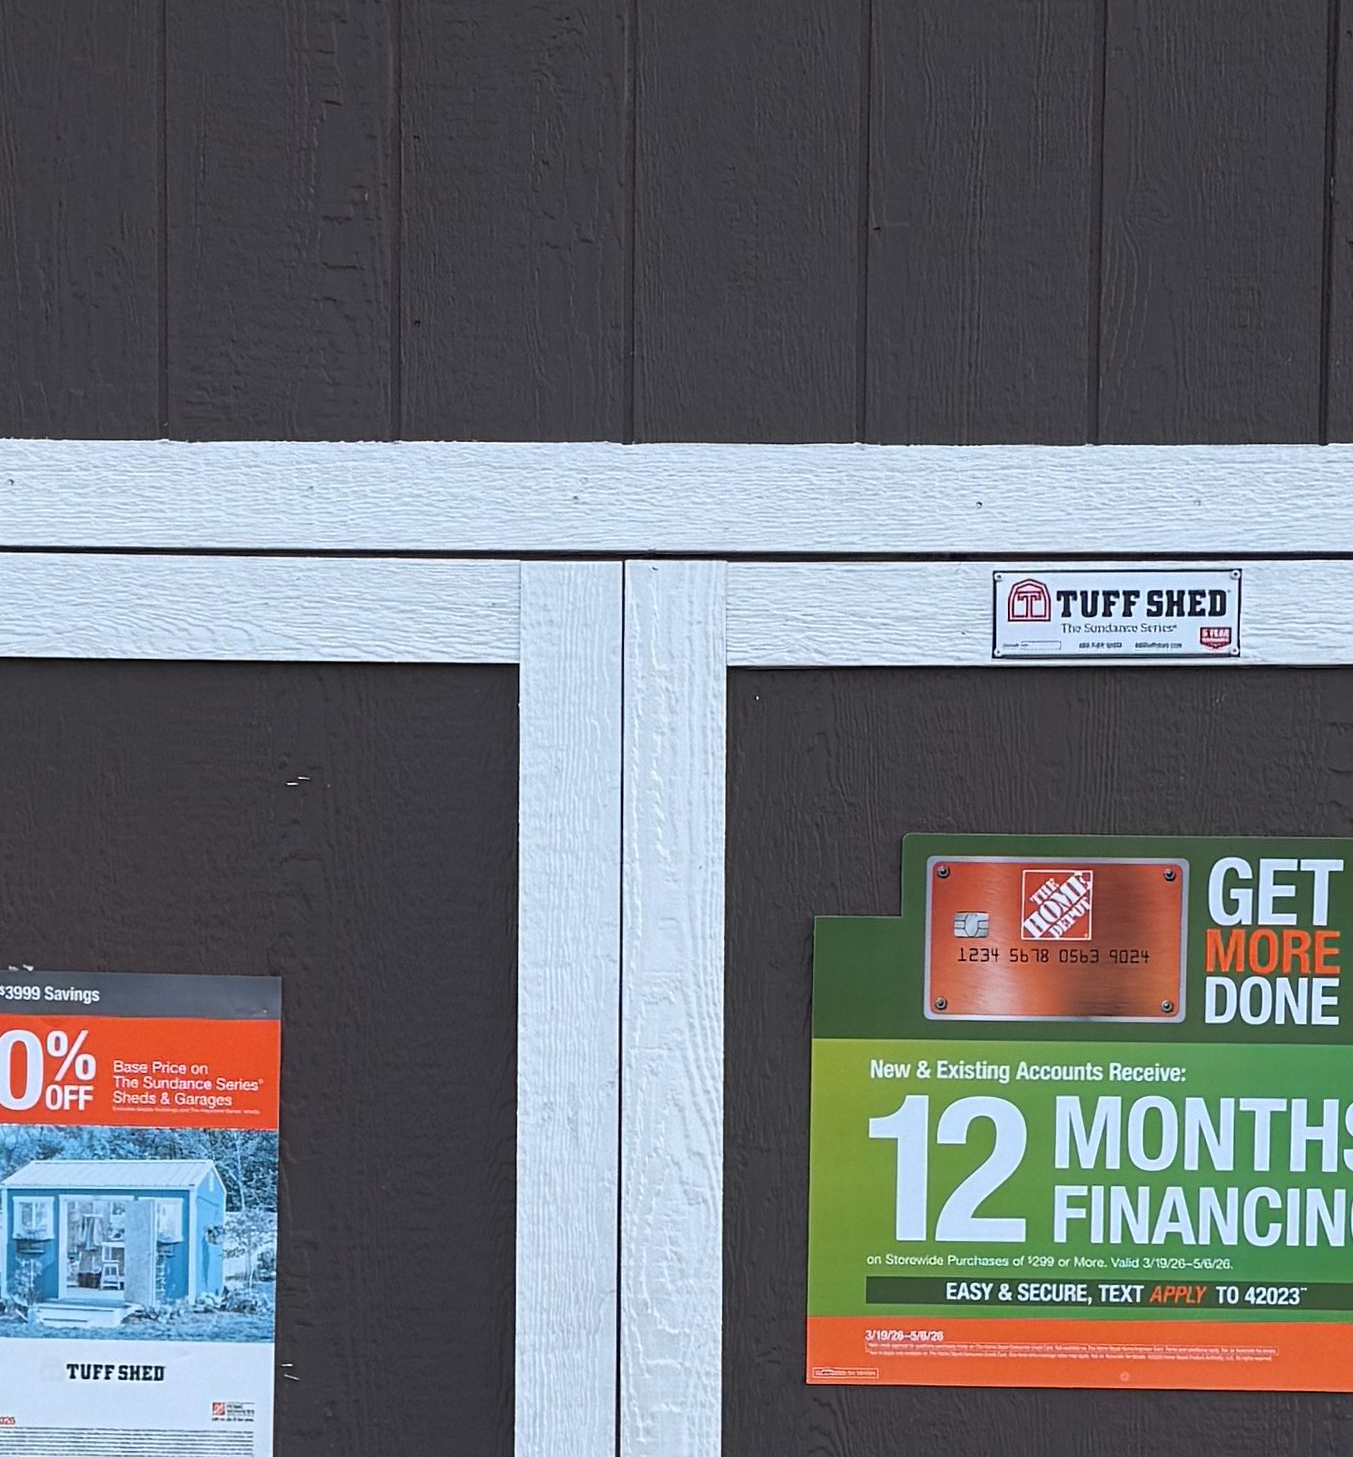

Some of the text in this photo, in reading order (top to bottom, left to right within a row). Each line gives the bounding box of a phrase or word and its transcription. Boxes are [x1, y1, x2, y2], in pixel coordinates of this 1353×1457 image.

[1056, 589, 1228, 618] TUFF SHED
[1061, 623, 1082, 634] The
[1084, 622, 1138, 634] Sundance
[1207, 857, 1344, 927] GET
[957, 947, 1151, 965] 1234 5678 0563 9024
[1205, 929, 1341, 975] MORE
[44, 985, 100, 1004] Savings
[1204, 977, 1340, 1026] DONE
[113, 1060, 209, 1075] Base Price on
[869, 1060, 1187, 1084] New & Existing Accounts Receive:
[113, 1075, 139, 1089] The
[142, 1075, 212, 1090] Sundance
[45, 1084, 95, 1112] OFF
[113, 1090, 233, 1109] Sheds & Garages
[868, 1093, 1027, 1243] 12
[866, 1255, 882, 1265] on
[885, 1253, 944, 1266] Storewide
[947, 1254, 1009, 1267] Purchases
[1012, 1255, 1024, 1267] of
[1027, 1255, 1055, 1268] $299
[1057, 1258, 1071, 1268] or
[1073, 1257, 1107, 1268] More.
[1110, 1257, 1140, 1268] Valid
[946, 1282, 994, 1301] EASY
[998, 1282, 1013, 1301] &
[1017, 1282, 1094, 1306] SECURE,
[1098, 1284, 1145, 1303] TEXT
[1149, 1285, 1208, 1305] APPLY
[1215, 1285, 1240, 1304] TO
[66, 1362, 165, 1382] TUFF SHED
